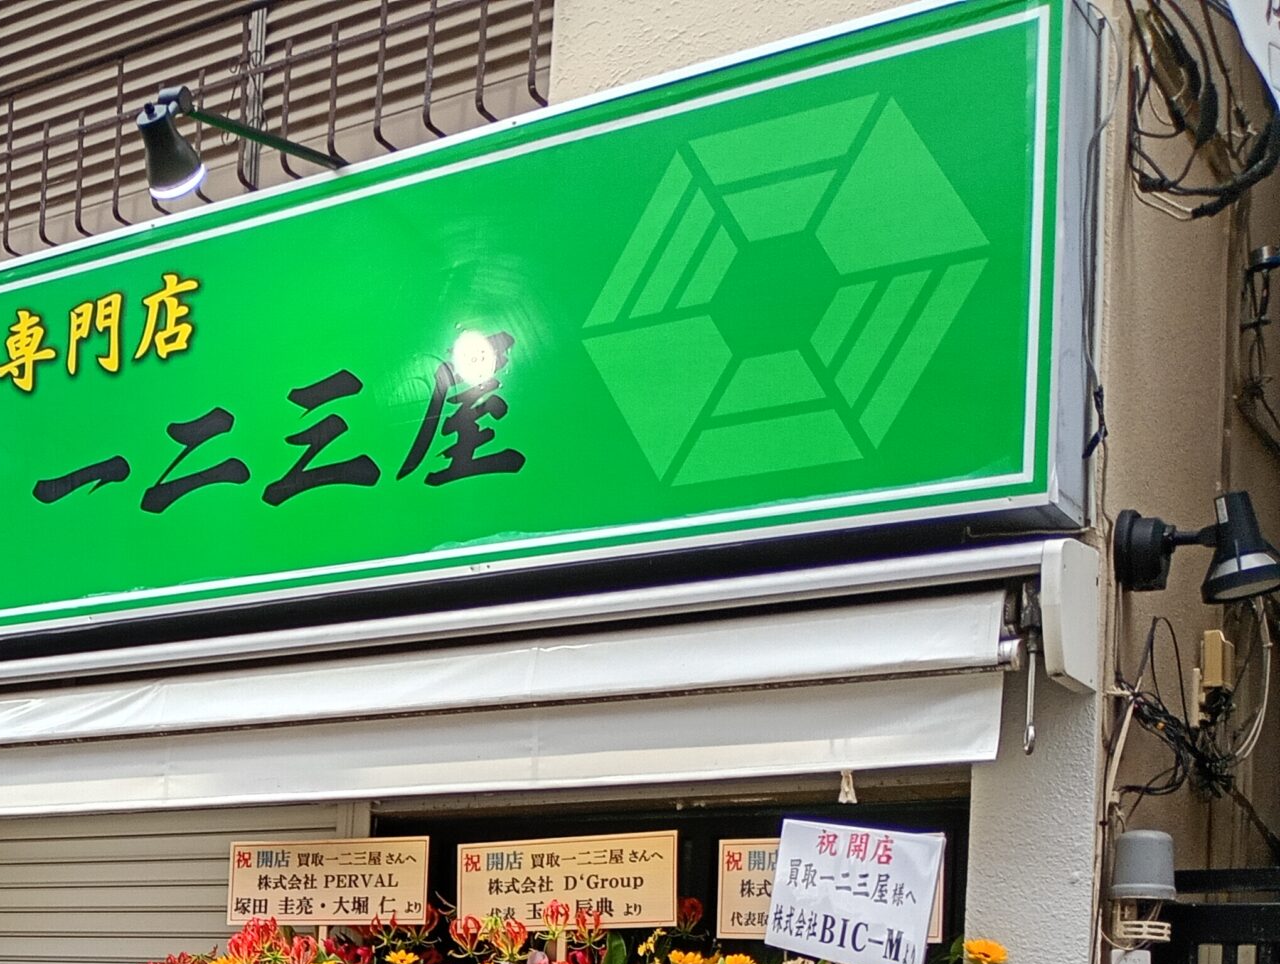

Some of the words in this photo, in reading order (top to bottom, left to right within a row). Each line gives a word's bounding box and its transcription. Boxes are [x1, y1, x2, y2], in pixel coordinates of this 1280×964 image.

[257, 850, 291, 868] 開店
[486, 851, 523, 871] 開店
[257, 874, 318, 891] 株式会社
[324, 873, 399, 888] PERVAL
[488, 876, 554, 895] 株式会社
[404, 901, 422, 914] より
[623, 902, 642, 916] より
